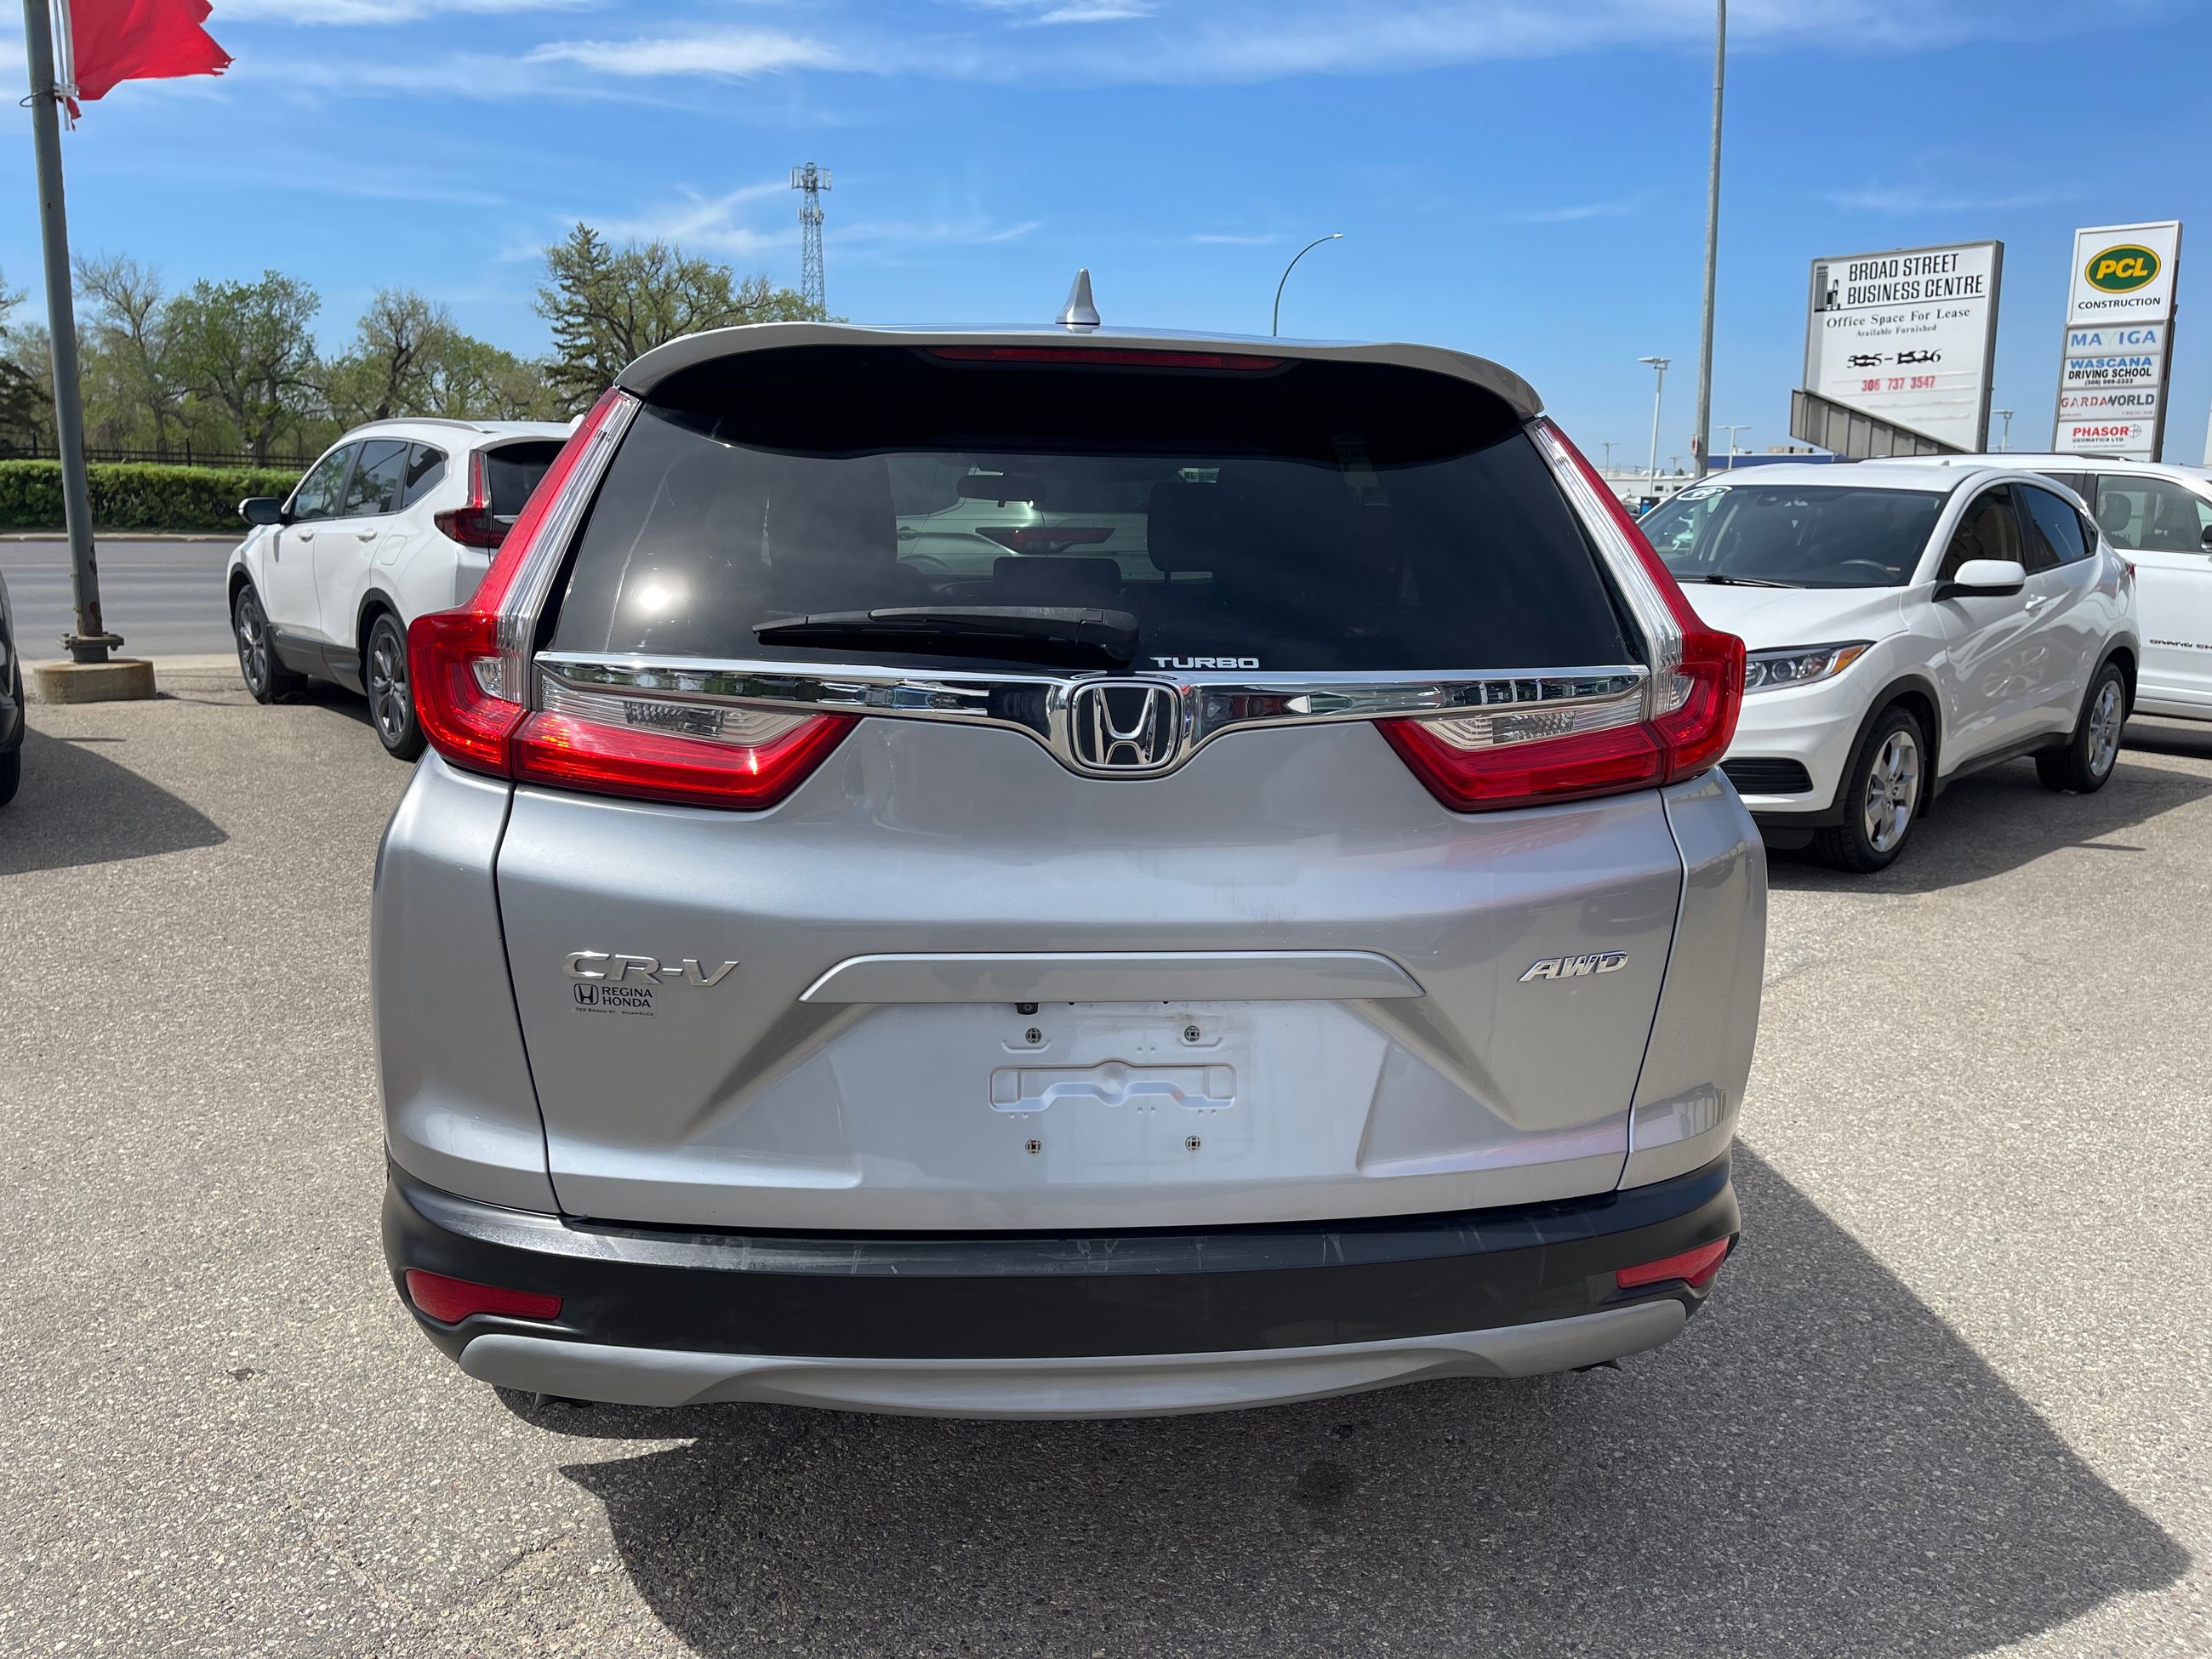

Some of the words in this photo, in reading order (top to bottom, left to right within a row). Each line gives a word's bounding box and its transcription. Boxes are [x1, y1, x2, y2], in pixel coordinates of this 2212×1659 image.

[1849, 259, 1899, 282] BROAD
[1903, 254, 1959, 276] STREET
[2095, 257, 2149, 280] PCL
[1847, 281, 1920, 305] BUSINESS
[1924, 275, 1984, 297] CENTRE
[2078, 297, 2161, 310] CONSTRUCTION
[1827, 316, 1866, 328] Office
[1871, 313, 1905, 328] Space
[1911, 309, 1931, 322] For
[1936, 307, 1970, 320] Lease
[1856, 328, 1892, 338] Available
[1896, 324, 1937, 334] Furnished
[2070, 356, 2152, 369] WASCANA
[2068, 369, 2108, 380] DRIVING
[2112, 368, 2152, 379] SCHOOL
[1861, 379, 1880, 391] 306
[1887, 377, 1906, 391] 737
[1910, 375, 1936, 390] 3547
[2072, 425, 2129, 437] PHASOR
[1149, 657, 1260, 669] TURBO
[562, 951, 740, 987] CR-V
[1518, 950, 1628, 982] AWD
[601, 986, 653, 998] REGINA
[602, 996, 651, 1007] HONDA
